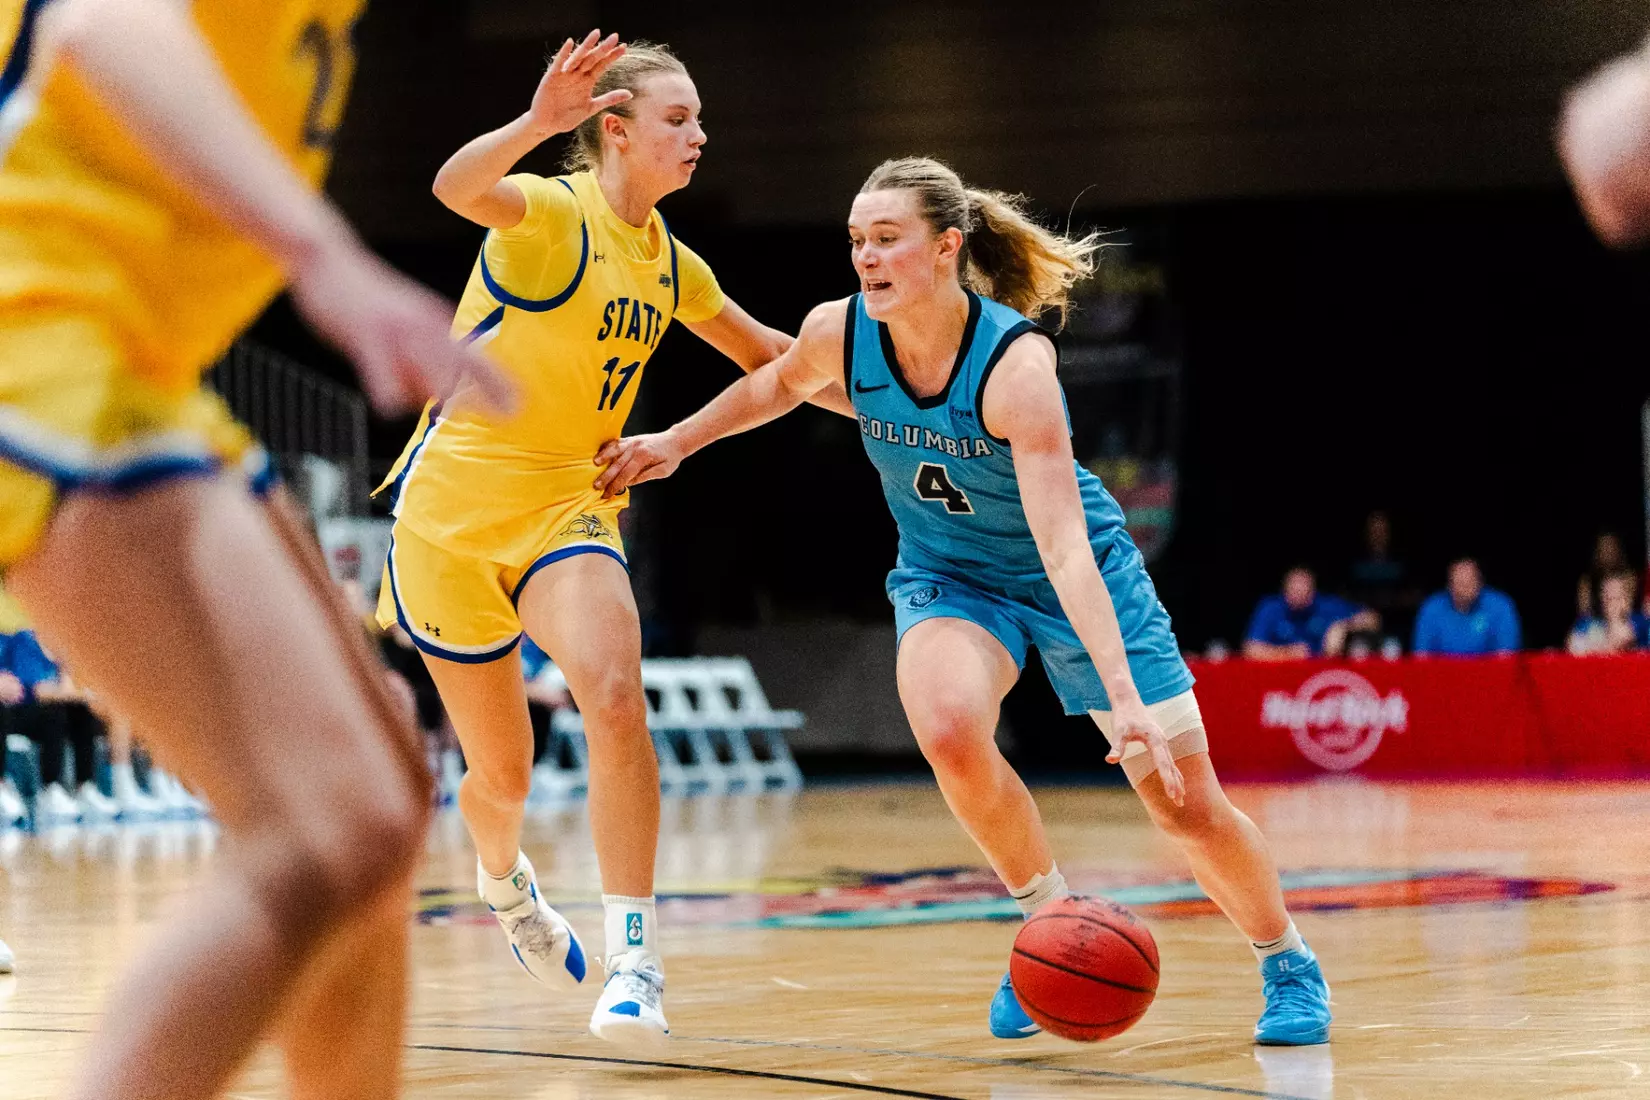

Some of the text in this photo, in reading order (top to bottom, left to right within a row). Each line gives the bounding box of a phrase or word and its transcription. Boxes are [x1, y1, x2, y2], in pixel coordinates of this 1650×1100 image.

[597, 356, 641, 411] 11
[859, 413, 993, 459] COLUMBIA
[913, 461, 975, 515] 4
